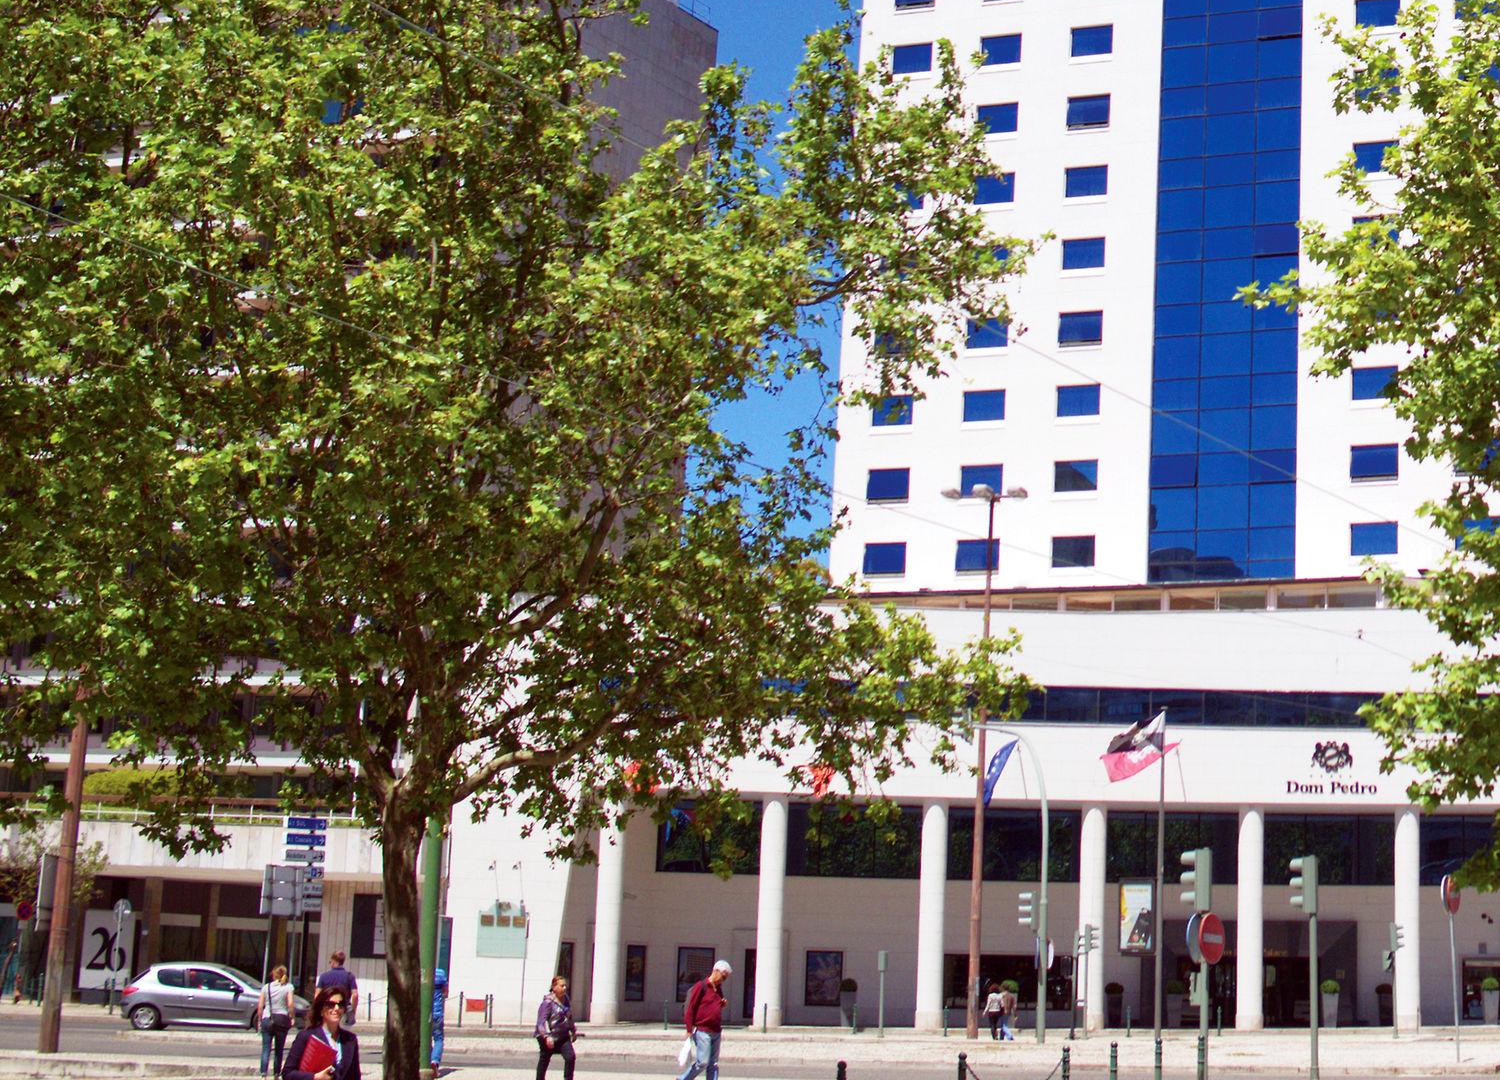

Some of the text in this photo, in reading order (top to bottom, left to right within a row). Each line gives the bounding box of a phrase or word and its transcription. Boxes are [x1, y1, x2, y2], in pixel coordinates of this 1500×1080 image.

[1286, 780, 1378, 794] Dom Pedro
[86, 926, 127, 972] 26
